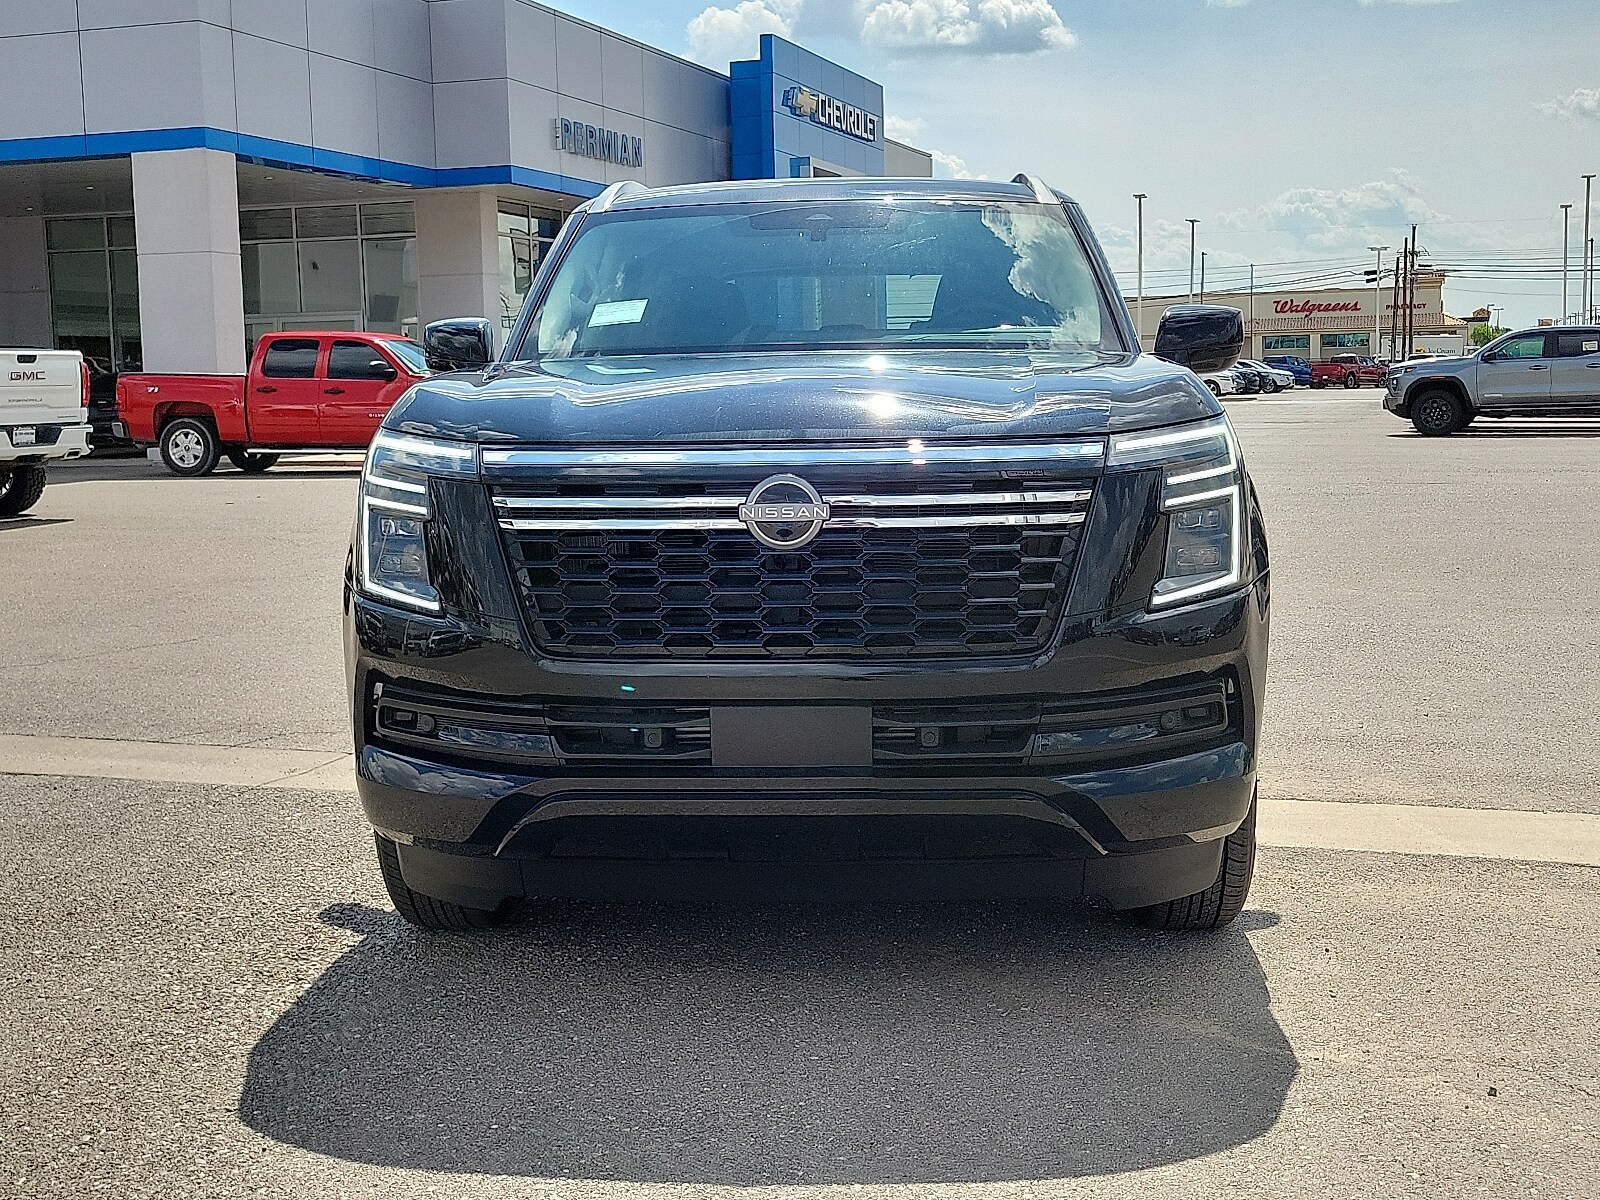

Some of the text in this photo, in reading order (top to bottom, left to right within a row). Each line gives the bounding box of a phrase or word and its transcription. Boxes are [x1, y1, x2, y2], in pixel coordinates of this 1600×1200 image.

[818, 93, 878, 142] CHEVROLET
[556, 117, 643, 168] PERMIAN
[1273, 299, 1361, 319] Walgreens
[1385, 302, 1427, 310] PAACY
[10, 371, 47, 381] GMC
[741, 506, 827, 519] NISSAN
